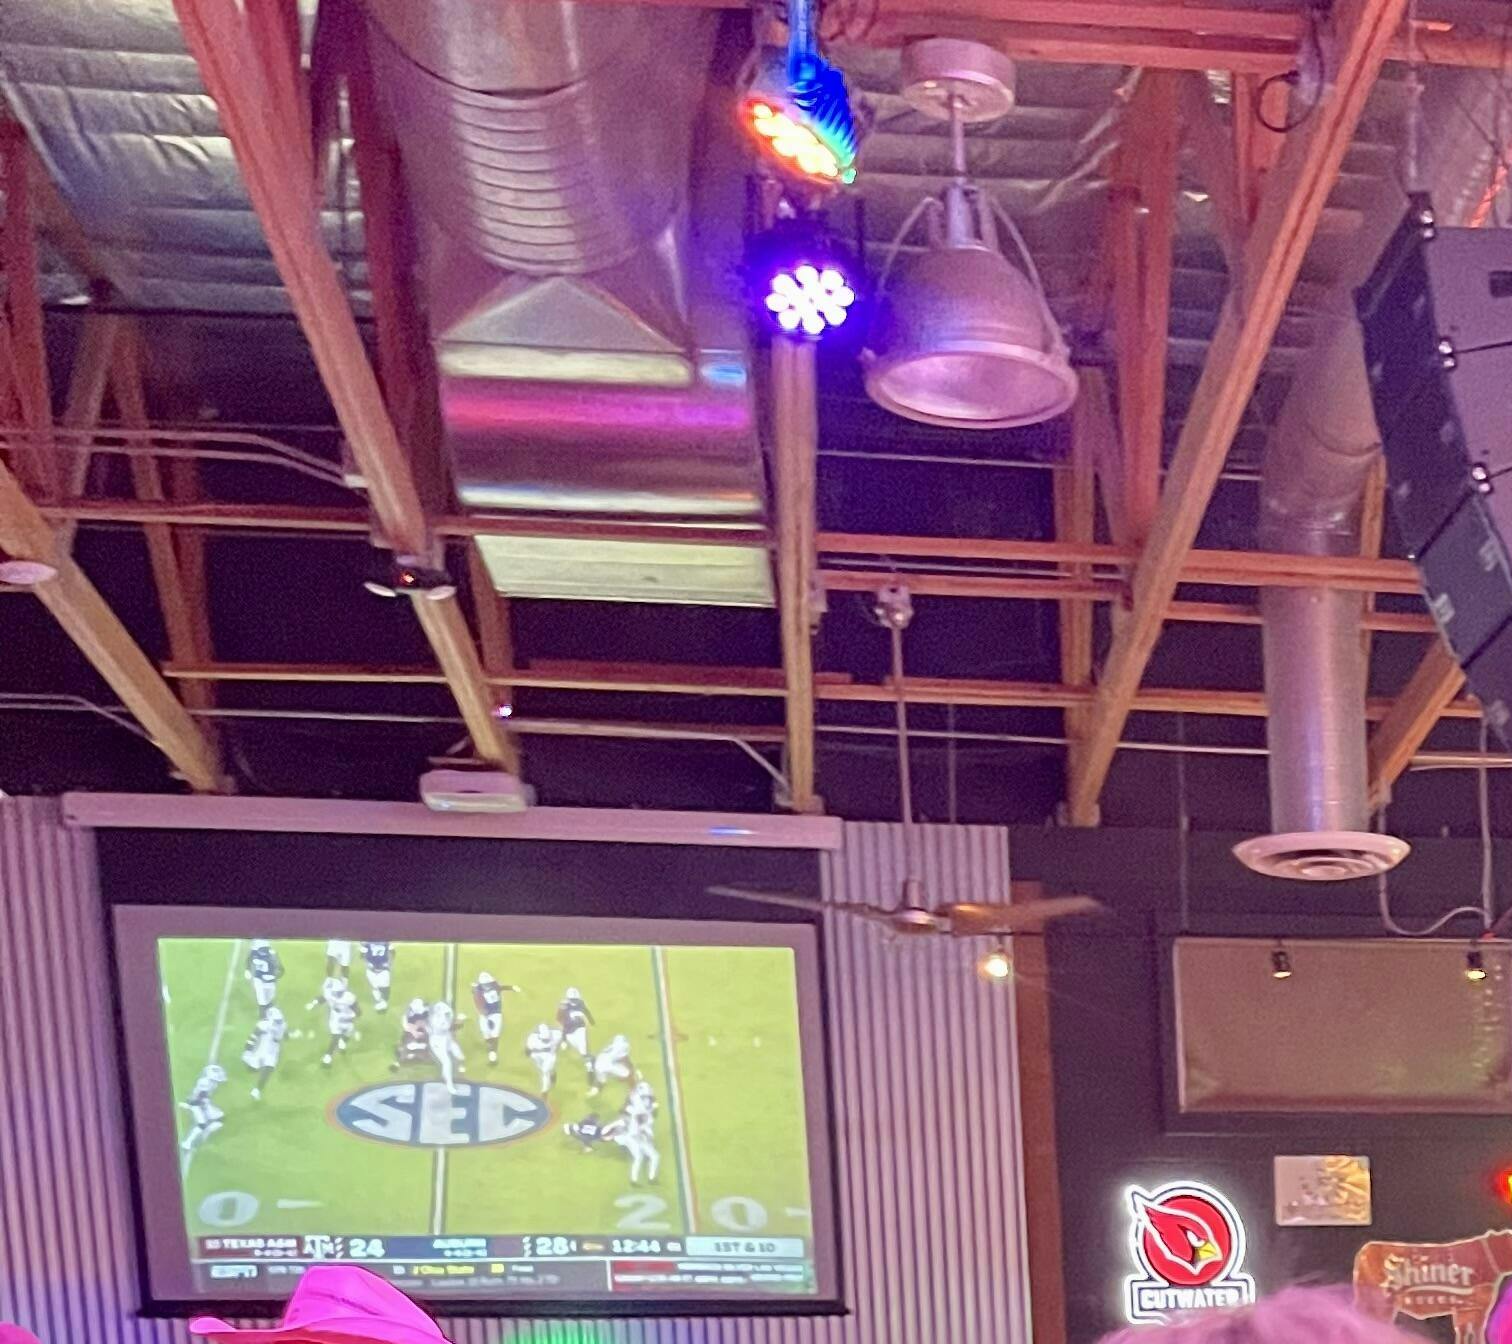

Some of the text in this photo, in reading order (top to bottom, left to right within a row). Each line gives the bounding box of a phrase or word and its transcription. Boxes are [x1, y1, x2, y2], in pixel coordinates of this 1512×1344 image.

[350, 1081, 538, 1144] SEC
[349, 1238, 386, 1258] 24
[1379, 1254, 1475, 1292] Shiner
[1141, 1289, 1240, 1309] CUTWATER
